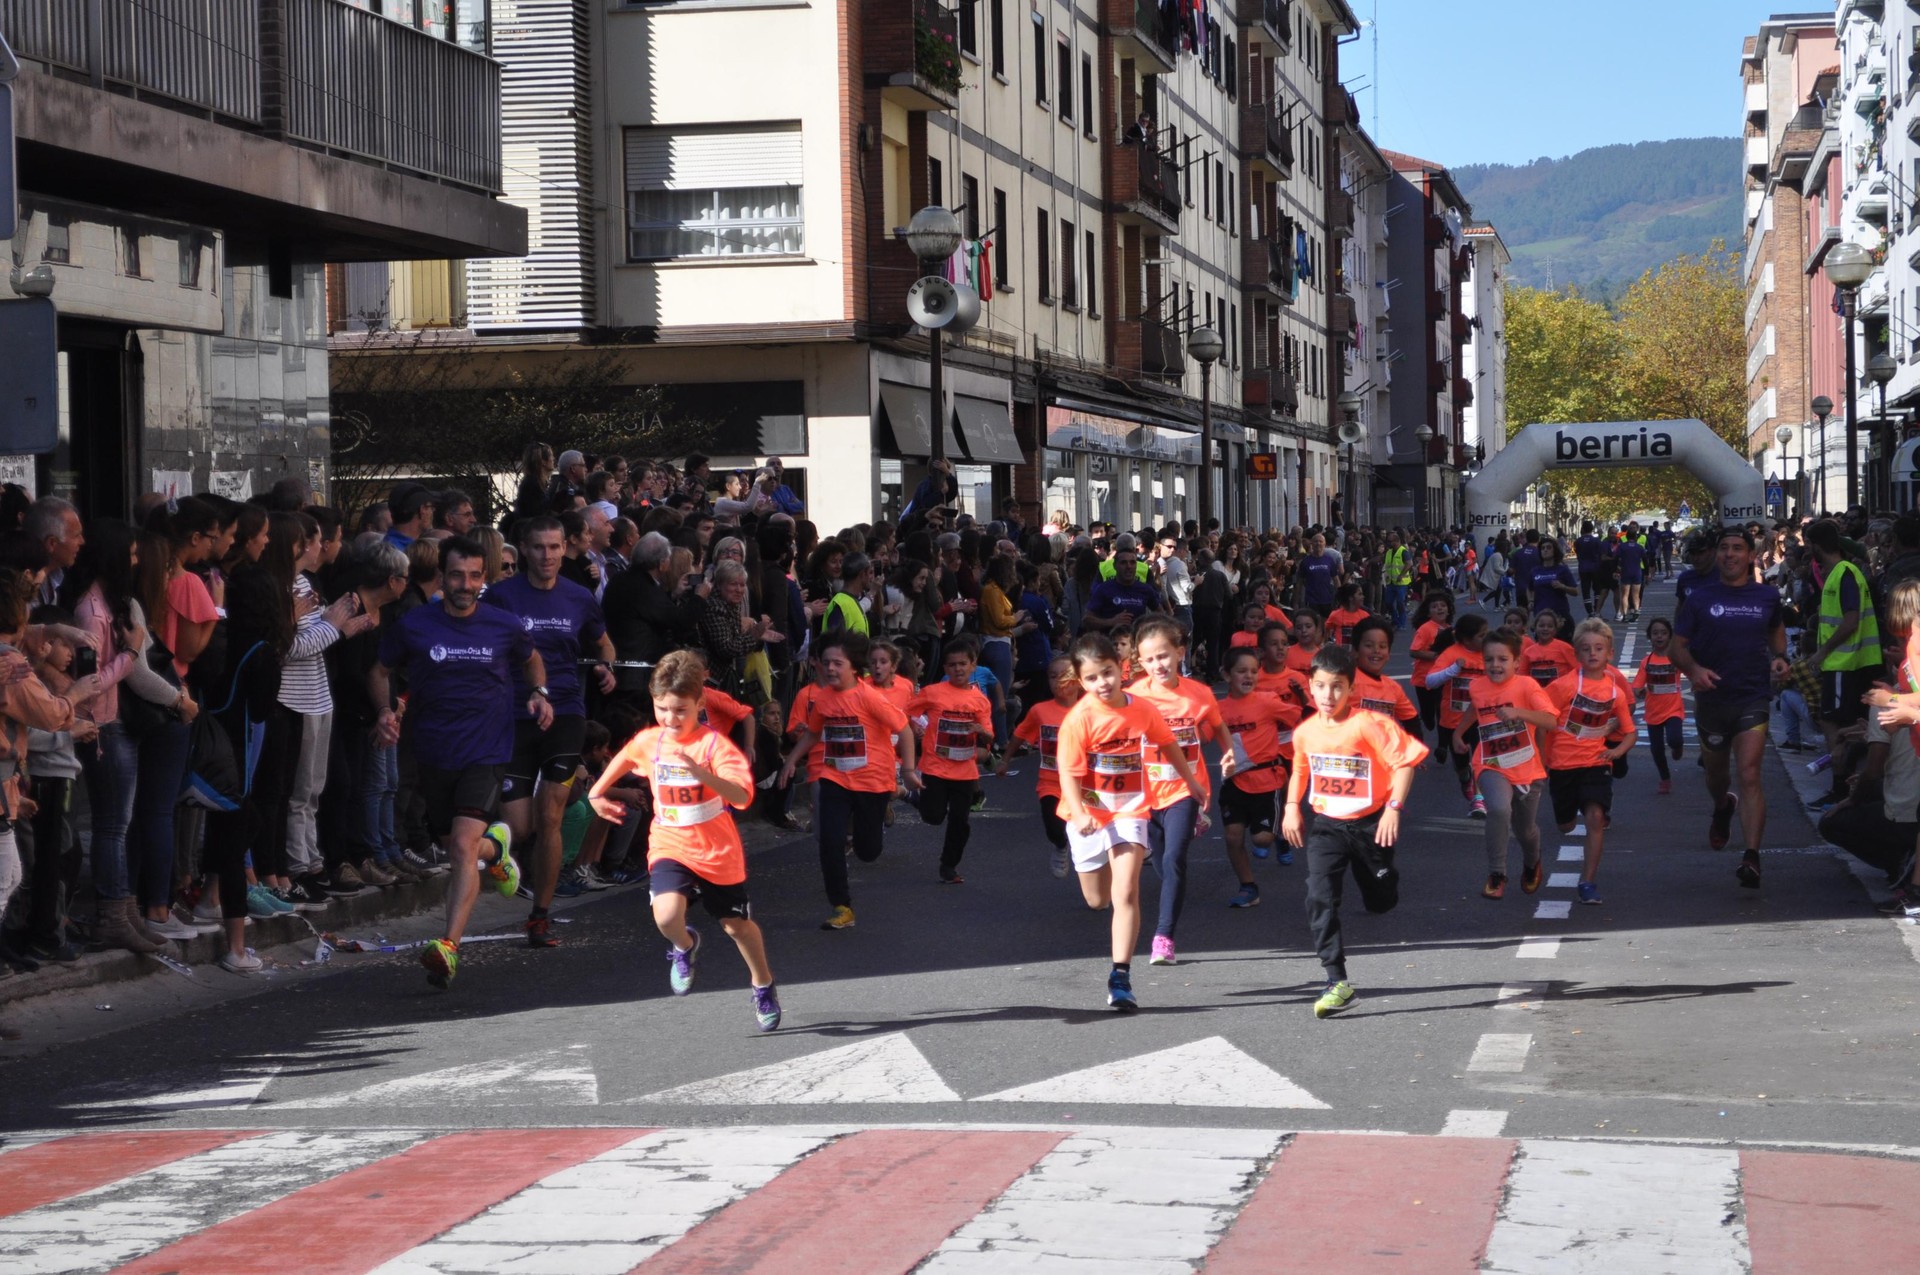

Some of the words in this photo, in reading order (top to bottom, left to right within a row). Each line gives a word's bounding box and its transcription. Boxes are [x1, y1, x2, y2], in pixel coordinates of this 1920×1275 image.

[1556, 427, 1672, 460] berria
[1469, 511, 1508, 525] berria
[1723, 503, 1763, 517] berria
[1100, 775, 1125, 791] 76
[1319, 778, 1357, 796] 252
[667, 785, 705, 803] 187
